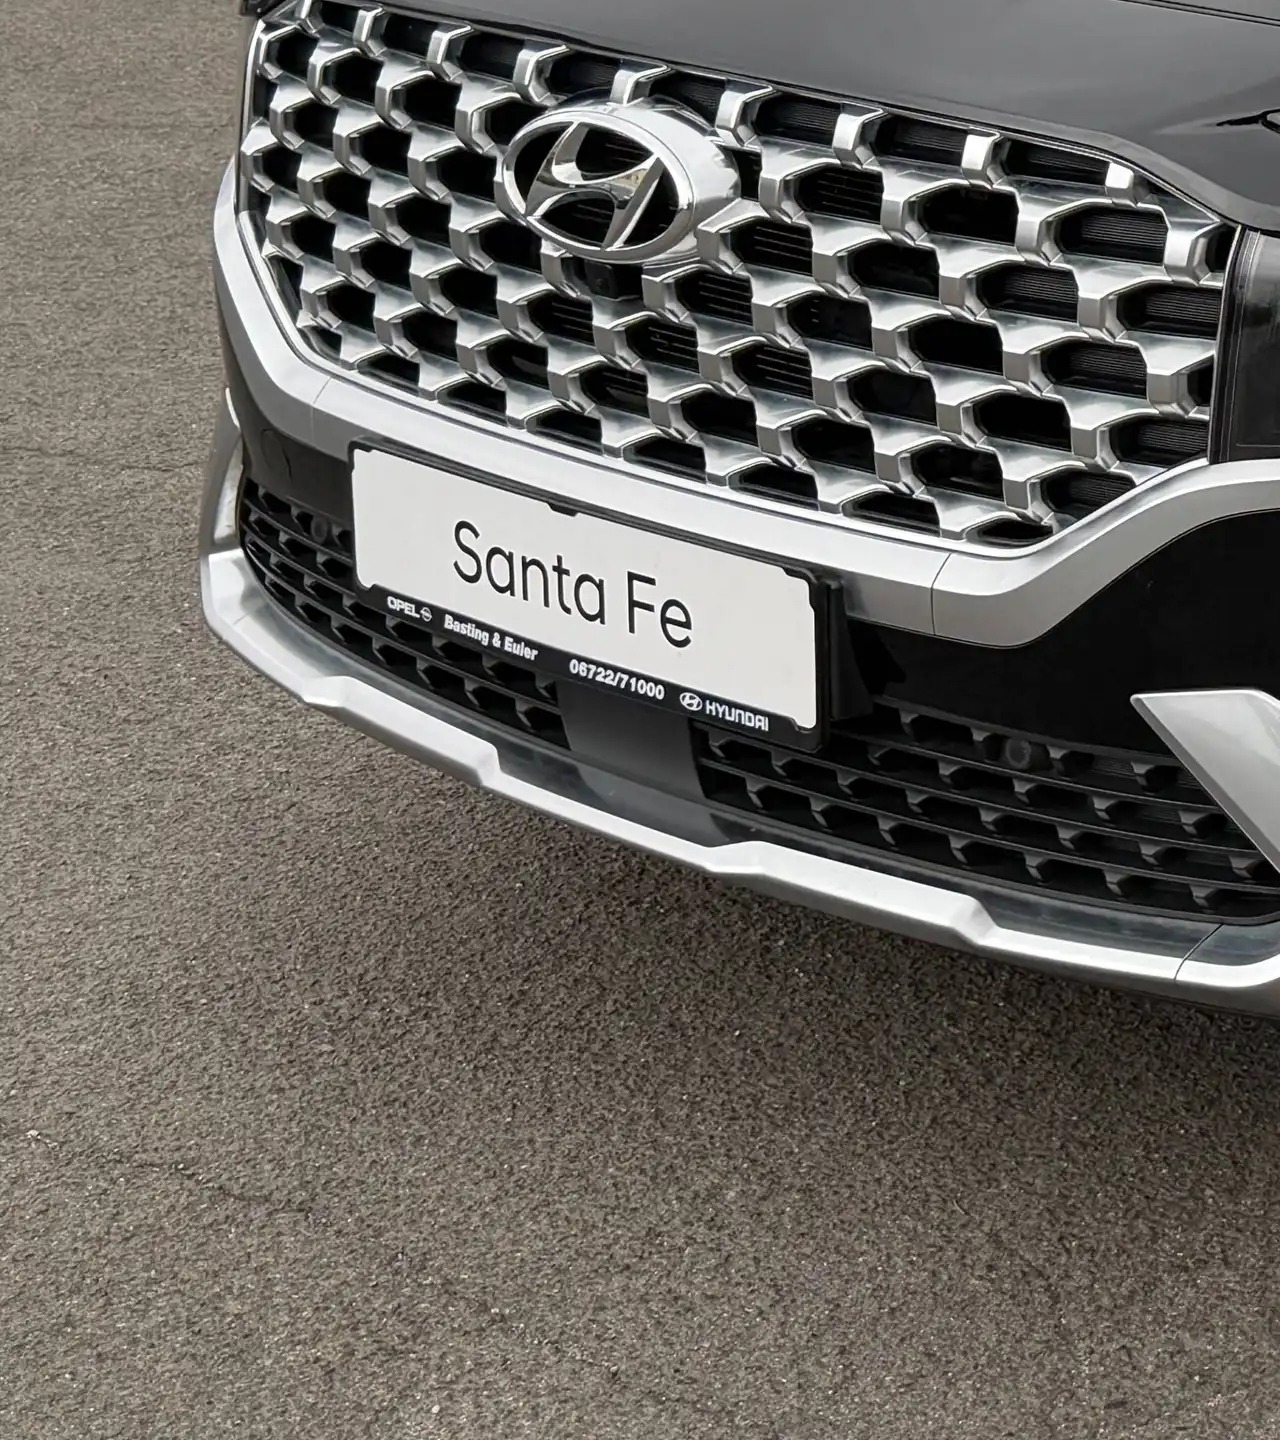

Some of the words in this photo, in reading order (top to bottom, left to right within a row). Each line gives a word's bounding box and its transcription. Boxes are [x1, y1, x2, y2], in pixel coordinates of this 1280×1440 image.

[453, 520, 606, 625] Santa
[627, 571, 693, 648] Fe
[387, 596, 420, 619] OPEL
[444, 613, 490, 647] Basting
[492, 632, 501, 648] &
[504, 636, 539, 661] Euler
[569, 658, 665, 700] 06722/71000
[705, 699, 769, 732] HYUNDAI
